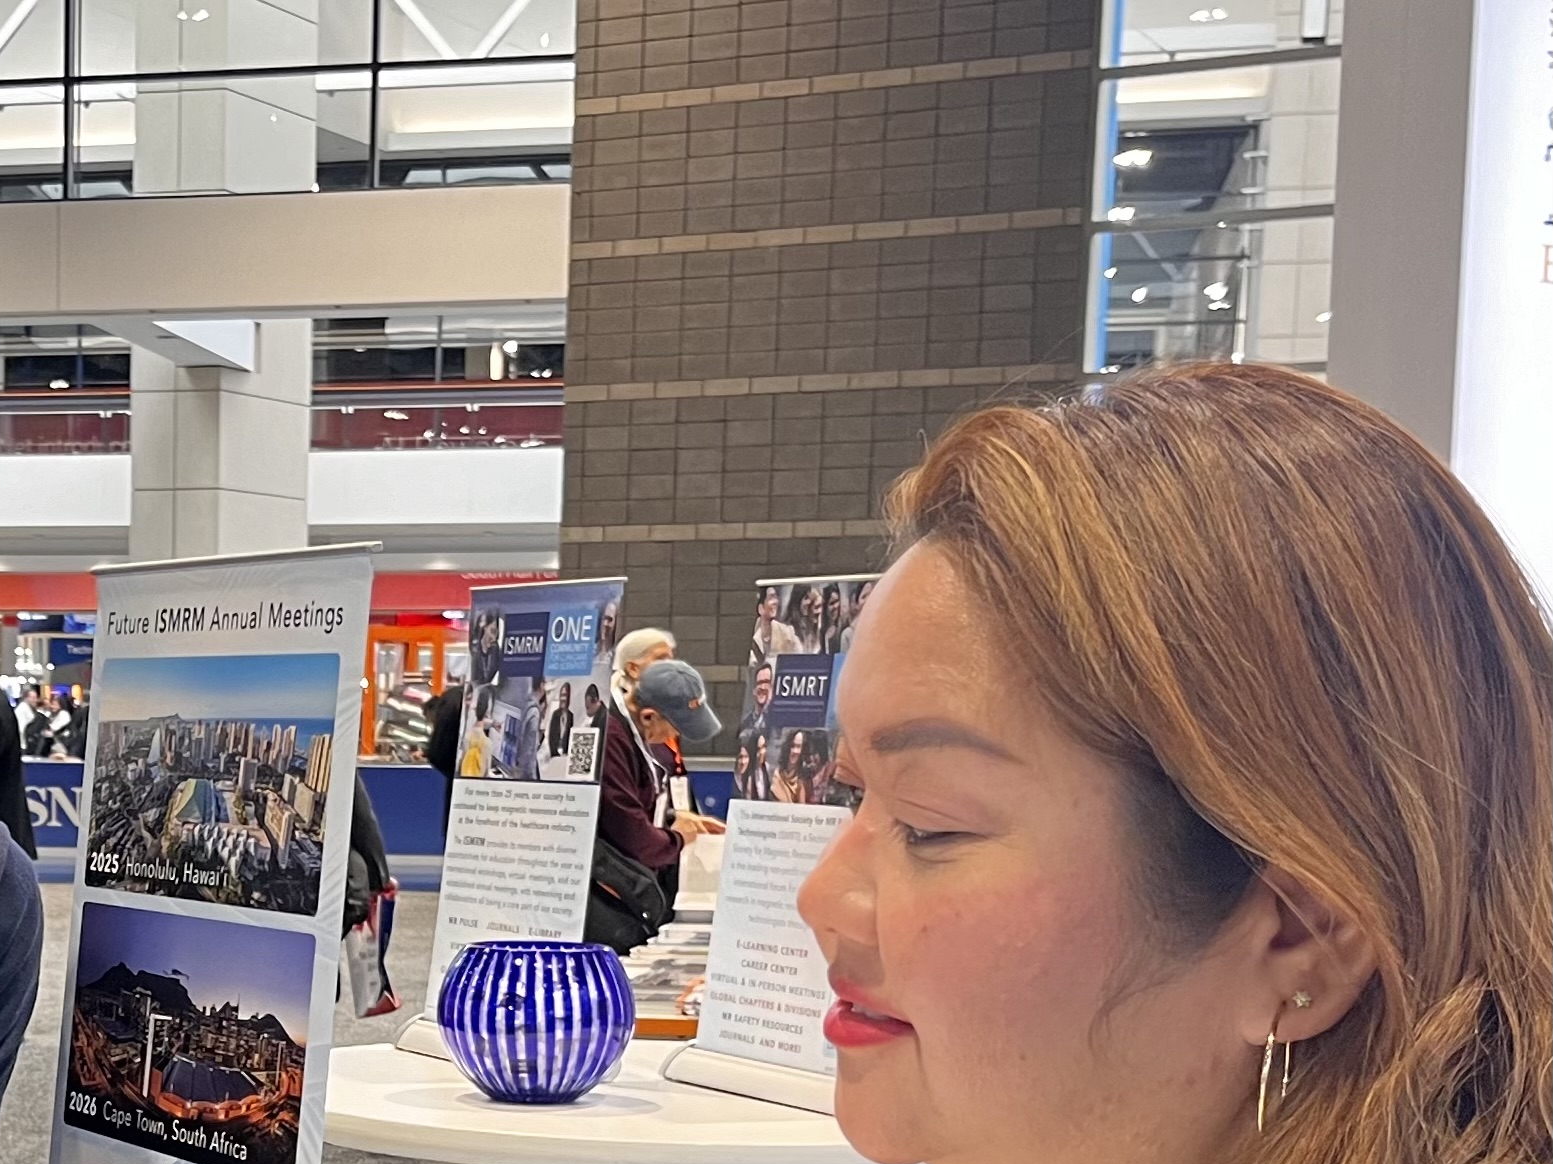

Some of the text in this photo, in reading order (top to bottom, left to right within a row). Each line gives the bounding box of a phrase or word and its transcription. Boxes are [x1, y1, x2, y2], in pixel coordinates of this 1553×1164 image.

[107, 600, 344, 635] Future ISMRM Annual Meetings
[551, 615, 592, 642] ONE
[504, 636, 544, 655] ISMRM
[776, 675, 828, 697] ISMRT
[89, 852, 119, 874] 2025
[125, 856, 179, 885] Honolulu,
[780, 946, 808, 958] CENTER
[741, 959, 798, 975] CAREER CENTER
[711, 972, 738, 985] VIRTUAL
[789, 985, 826, 1000] MEETINGS
[710, 991, 737, 1004] GLOBAL
[739, 995, 774, 1010] CHAPTERS
[784, 1004, 822, 1018] DIVISIONS
[722, 1012, 803, 1035] MR SAFETY RESOURCES
[719, 1029, 755, 1044] JOURNALS
[759, 1037, 775, 1048] AND
[69, 1091, 248, 1161] 2026 Cape Town, South Africa
